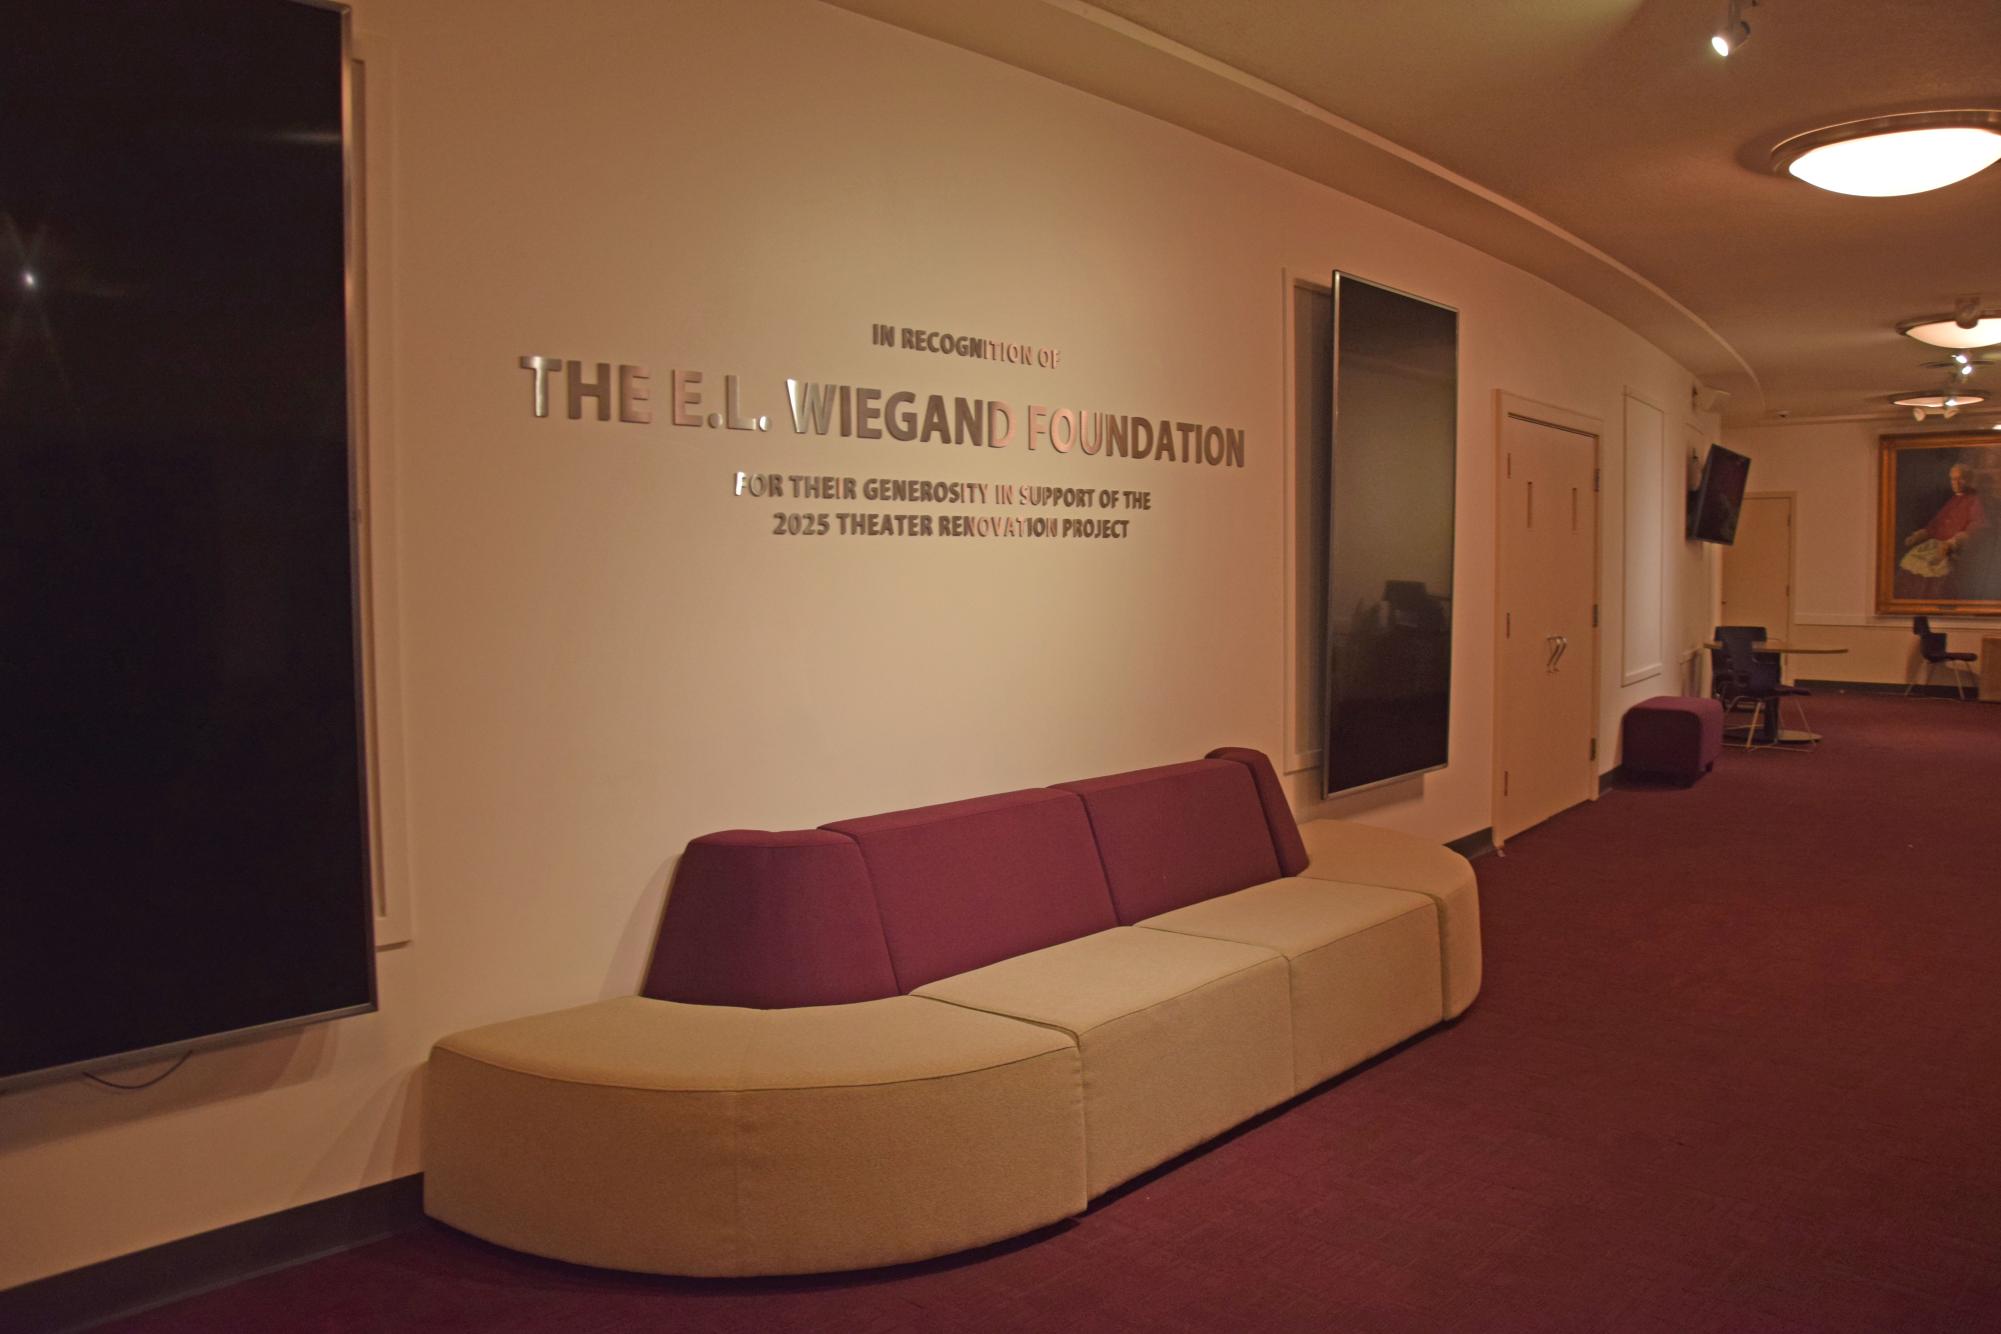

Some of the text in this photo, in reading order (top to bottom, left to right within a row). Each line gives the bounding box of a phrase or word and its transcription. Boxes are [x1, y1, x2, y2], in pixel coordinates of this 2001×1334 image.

[872, 323, 1060, 369] IN RECOGNITION OF
[519, 355, 1245, 468] THE E.L. WIEGAND FOUNDATION
[734, 471, 1152, 510] FOR THEIR GENEROSITY IN SUPPORT OF THE
[773, 512, 1130, 539] 2025 THEATER RENOVATION PROJECT
